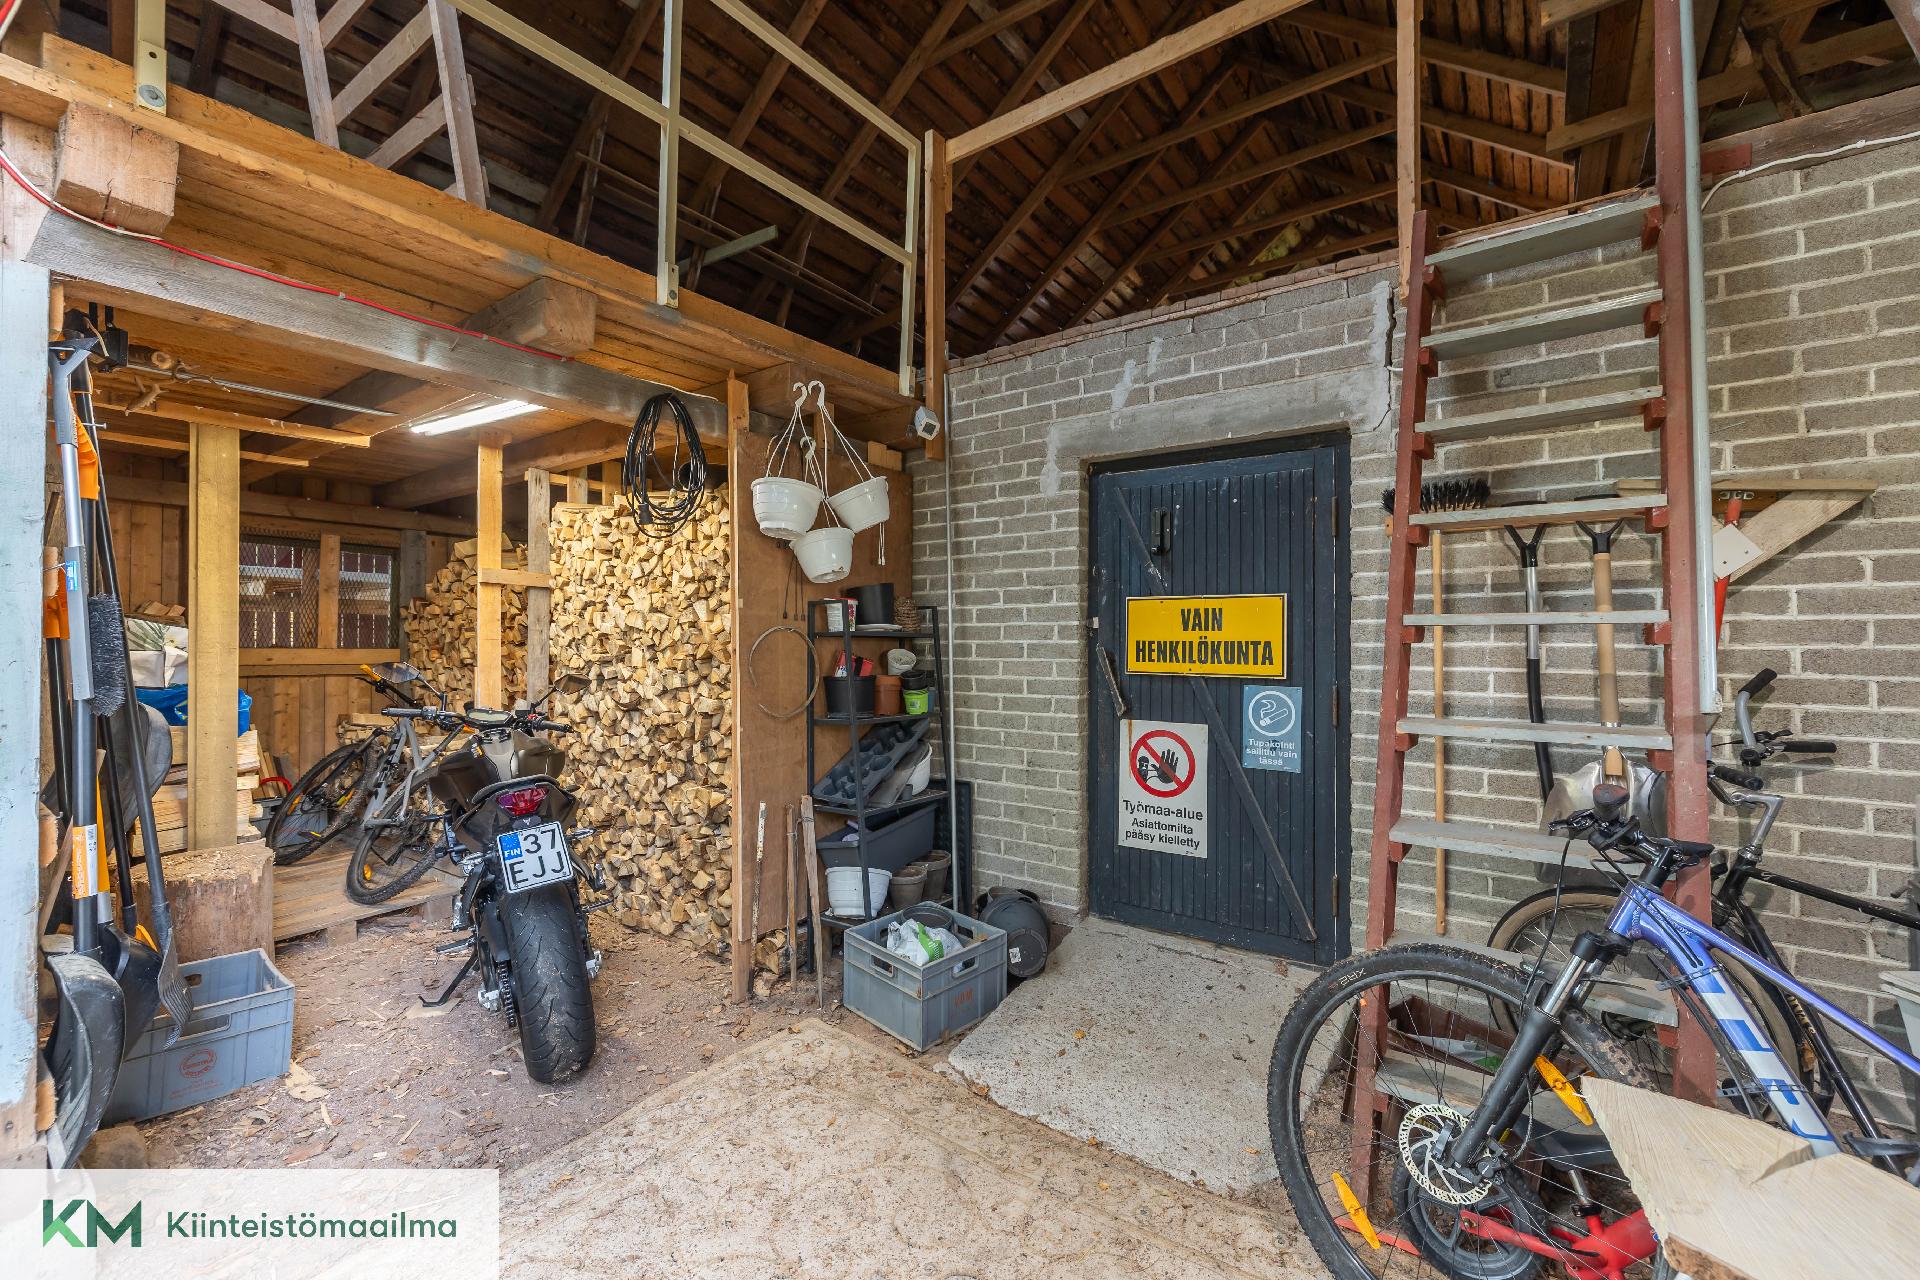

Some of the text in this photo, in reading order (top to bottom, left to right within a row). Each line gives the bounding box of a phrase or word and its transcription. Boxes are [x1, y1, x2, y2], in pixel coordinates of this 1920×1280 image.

[1181, 608, 1223, 632] VAIN
[1135, 635, 1274, 666] HENKILÖKUNTA
[1248, 738, 1295, 750] Tupakointi
[1278, 750, 1298, 759] vain
[1122, 799, 1203, 821] Työmaa-alue
[1131, 817, 1193, 835] Asiattomilta
[523, 828, 556, 854] 37
[1125, 828, 1200, 850] pääsy kielletty
[504, 847, 521, 858] FIN
[509, 851, 565, 884] EJJ
